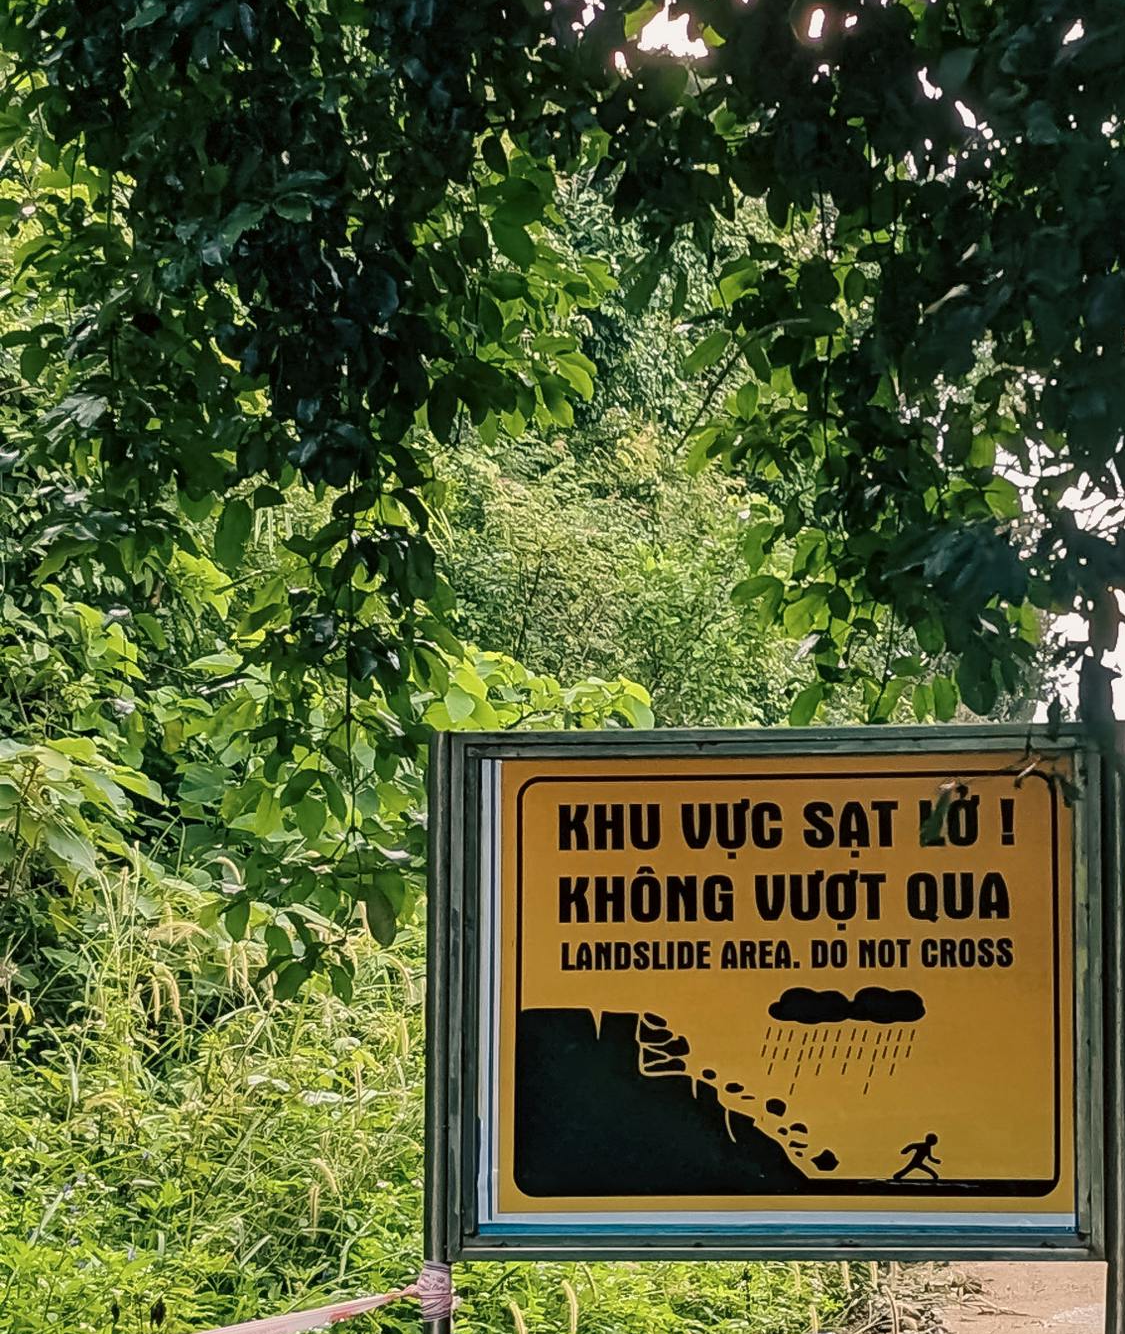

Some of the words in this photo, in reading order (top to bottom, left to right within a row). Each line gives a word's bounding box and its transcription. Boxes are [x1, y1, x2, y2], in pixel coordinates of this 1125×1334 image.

[558, 803, 661, 851] KHU
[681, 798, 783, 860] VỰC
[803, 800, 899, 858] SẠT
[559, 866, 734, 923] KHÔNG
[754, 869, 887, 931] VƯỢT
[906, 872, 1010, 923] QUA
[561, 940, 711, 971] LANDSLIDE
[721, 940, 800, 969] AREA.
[811, 939, 848, 969] DO
[858, 938, 911, 968] NOT
[921, 937, 1014, 968] CROSS
